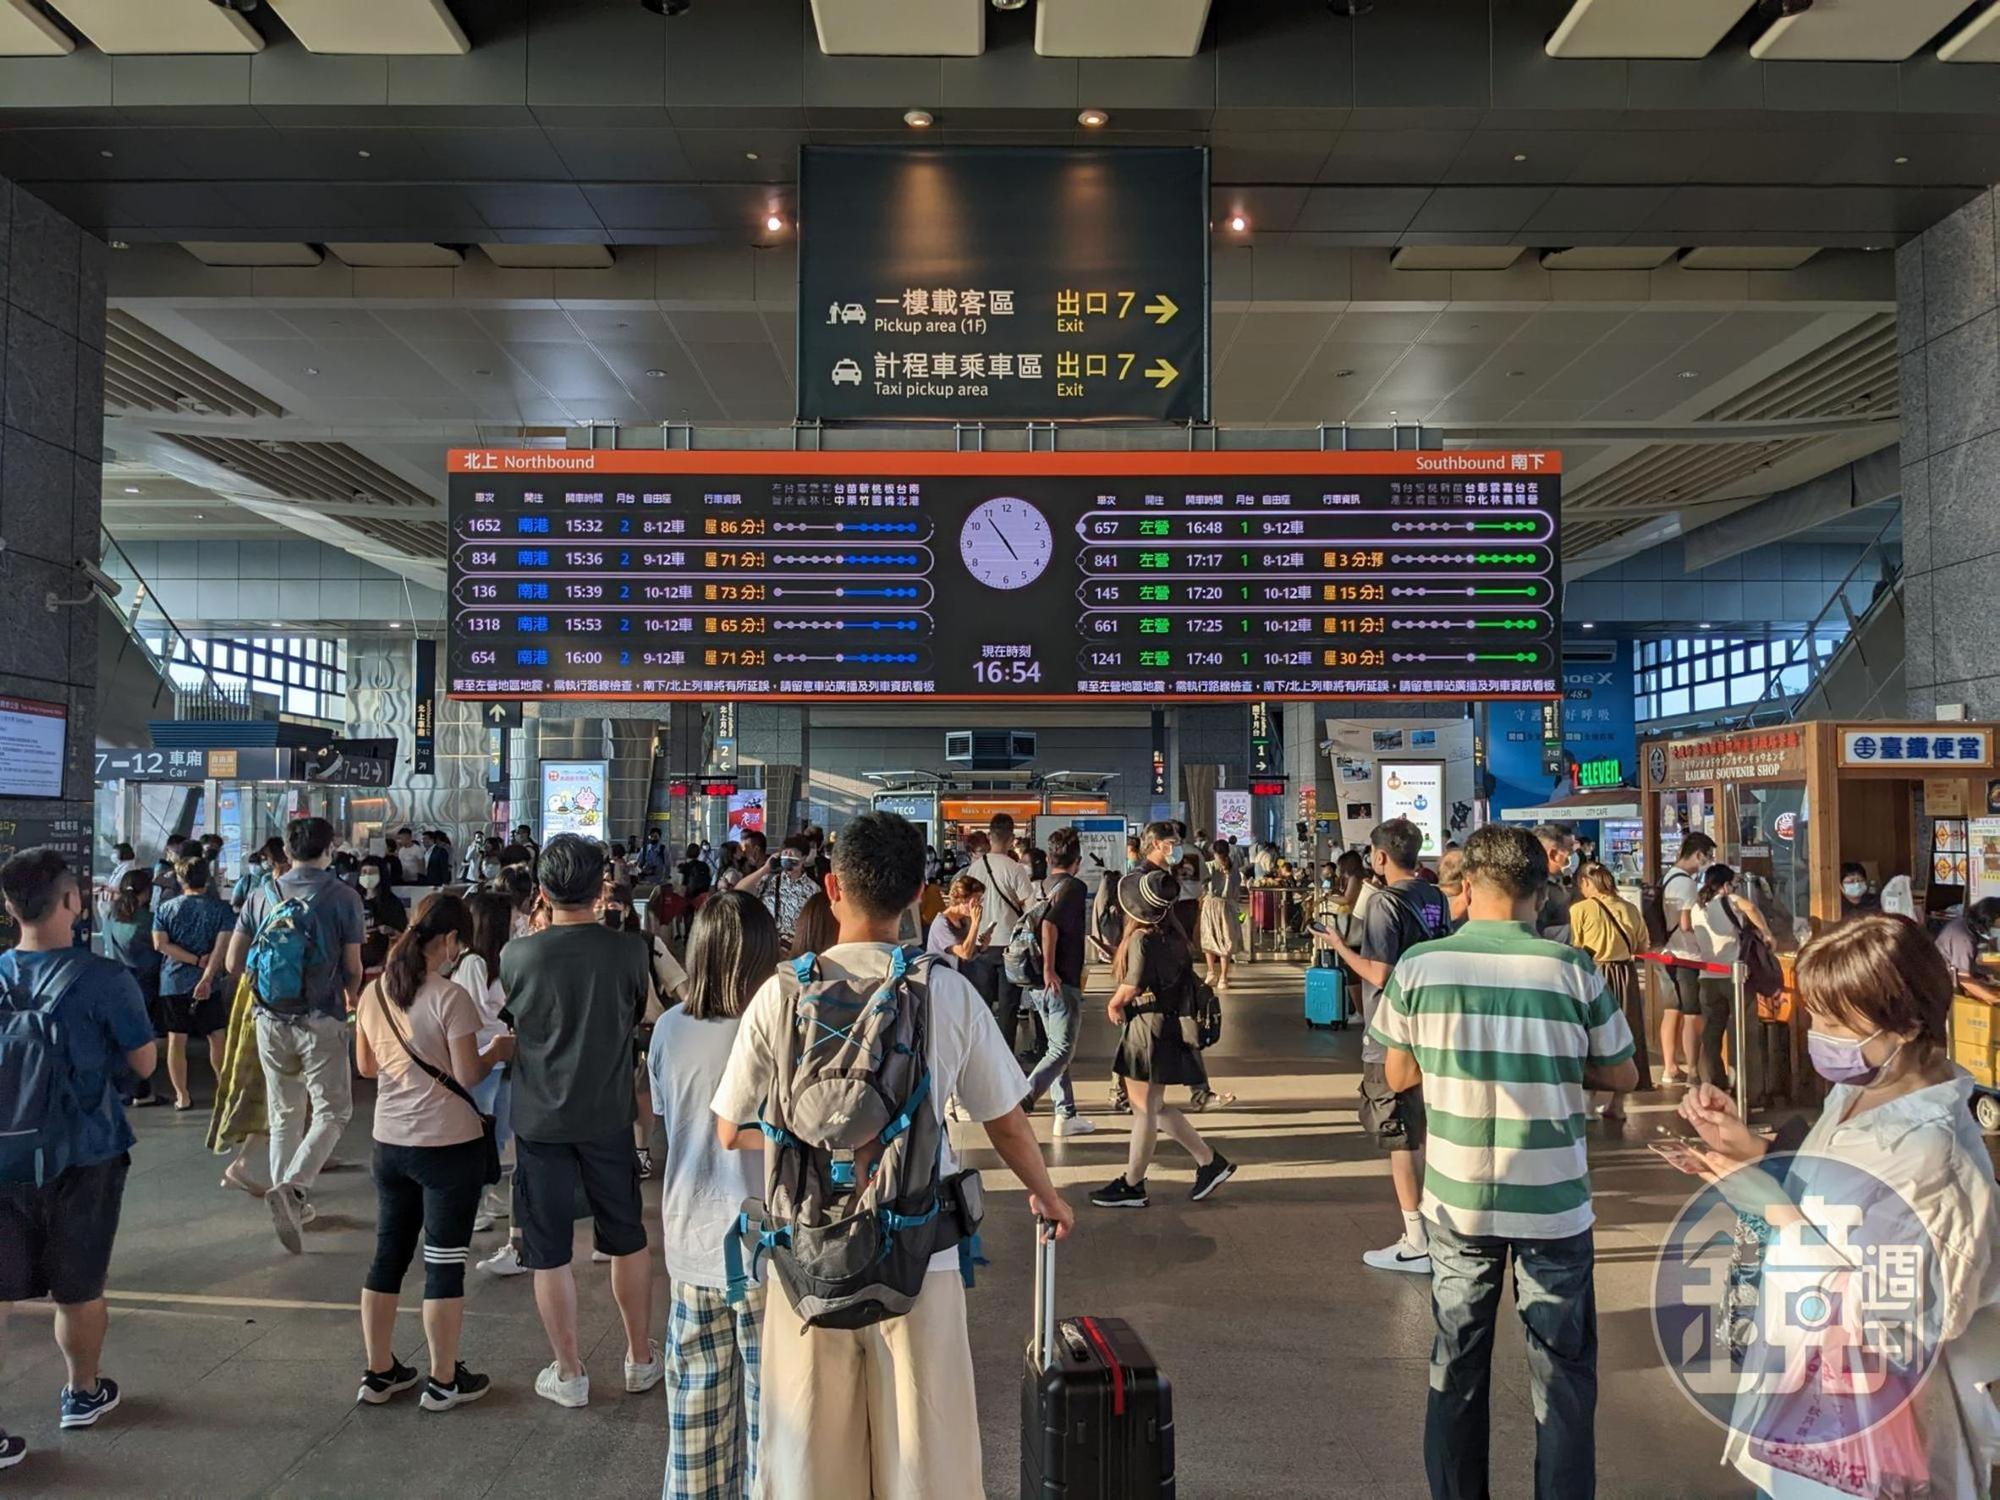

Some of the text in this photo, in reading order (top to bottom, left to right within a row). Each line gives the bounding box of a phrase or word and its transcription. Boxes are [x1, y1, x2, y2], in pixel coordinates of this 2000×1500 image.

[876, 288, 1135, 318] 一樓載客區 出口 7
[875, 318, 986, 334] Pickup area (1F)
[1058, 319, 1083, 332] Exit
[874, 351, 1134, 380] 計程車乘車區 出口 7
[874, 382, 988, 398] Taxi pickup area
[1058, 383, 1083, 396] Exit
[464, 453, 595, 469] 北上 Northbound
[1417, 454, 1545, 470] Southbound 南下
[1002, 504, 1011, 512] 12
[1024, 509, 1026, 517] 1
[469, 519, 500, 531] 1652
[566, 520, 602, 532] 15:32
[621, 520, 629, 532] 2
[644, 520, 685, 533] 8-12車
[721, 522, 737, 533] 86
[972, 522, 980, 530] 10
[1035, 522, 1040, 530] 2
[1095, 520, 1304, 535] 657 左營 16:48 1 9-12車
[967, 540, 972, 548] 9
[1041, 540, 1045, 548] 3
[472, 552, 496, 564] 834
[566, 552, 602, 565] 15:36
[621, 553, 629, 565] 2
[644, 552, 685, 566] 9-12車
[721, 554, 735, 566] 71
[972, 558, 978, 566] 8
[1095, 555, 1116, 566] 841
[1139, 553, 1170, 568] 左營
[1187, 554, 1222, 566] 17:17
[1242, 555, 1247, 566] 1
[1264, 553, 1304, 567] 8-12車
[1340, 554, 1348, 566] 3
[985, 571, 991, 579] 7
[1003, 576, 1009, 584] 6
[1022, 571, 1027, 579] 5
[473, 585, 496, 597] 136
[566, 586, 602, 597] 15:39
[620, 586, 629, 598] 2
[645, 585, 692, 599] 10-12車
[721, 587, 737, 598] 73
[1096, 588, 1118, 599] 145
[1139, 585, 1170, 600] 左營
[1187, 587, 1222, 599] 17:20
[1242, 587, 1247, 599] 1
[1265, 586, 1311, 599] 10-12車
[1341, 587, 1356, 599] 15
[469, 619, 500, 630] 1318
[566, 619, 602, 630] 15:53
[621, 619, 629, 631] 2
[645, 618, 692, 632] 10-12車
[721, 620, 737, 631] 65
[1095, 620, 1117, 632] 661
[1139, 618, 1170, 633] 左營
[1187, 620, 1222, 632] 17:25
[1242, 620, 1247, 631] 1
[1264, 618, 1312, 632] 10-12車
[1341, 620, 1355, 632] 11
[472, 652, 495, 663] 654
[566, 652, 602, 663] 16:00
[620, 652, 629, 665] 2
[644, 651, 684, 664] 9-12車
[721, 652, 735, 664] 71
[982, 645, 1031, 658] 現在時刻
[1092, 653, 1120, 664] 1241
[1139, 651, 1170, 666] 左營
[1187, 653, 1222, 664] 17:40
[1242, 653, 1247, 664] 1
[1264, 651, 1312, 665] 10-12車
[1340, 653, 1356, 664] 30
[973, 661, 1041, 682] 16:54
[721, 746, 729, 756] 2
[1257, 745, 1265, 756] 1
[169, 751, 202, 767] 車廂
[169, 767, 187, 778] Car
[1685, 763, 1780, 781] RAILWAY SOUVENIR SHOP
[893, 805, 915, 815] TECO
